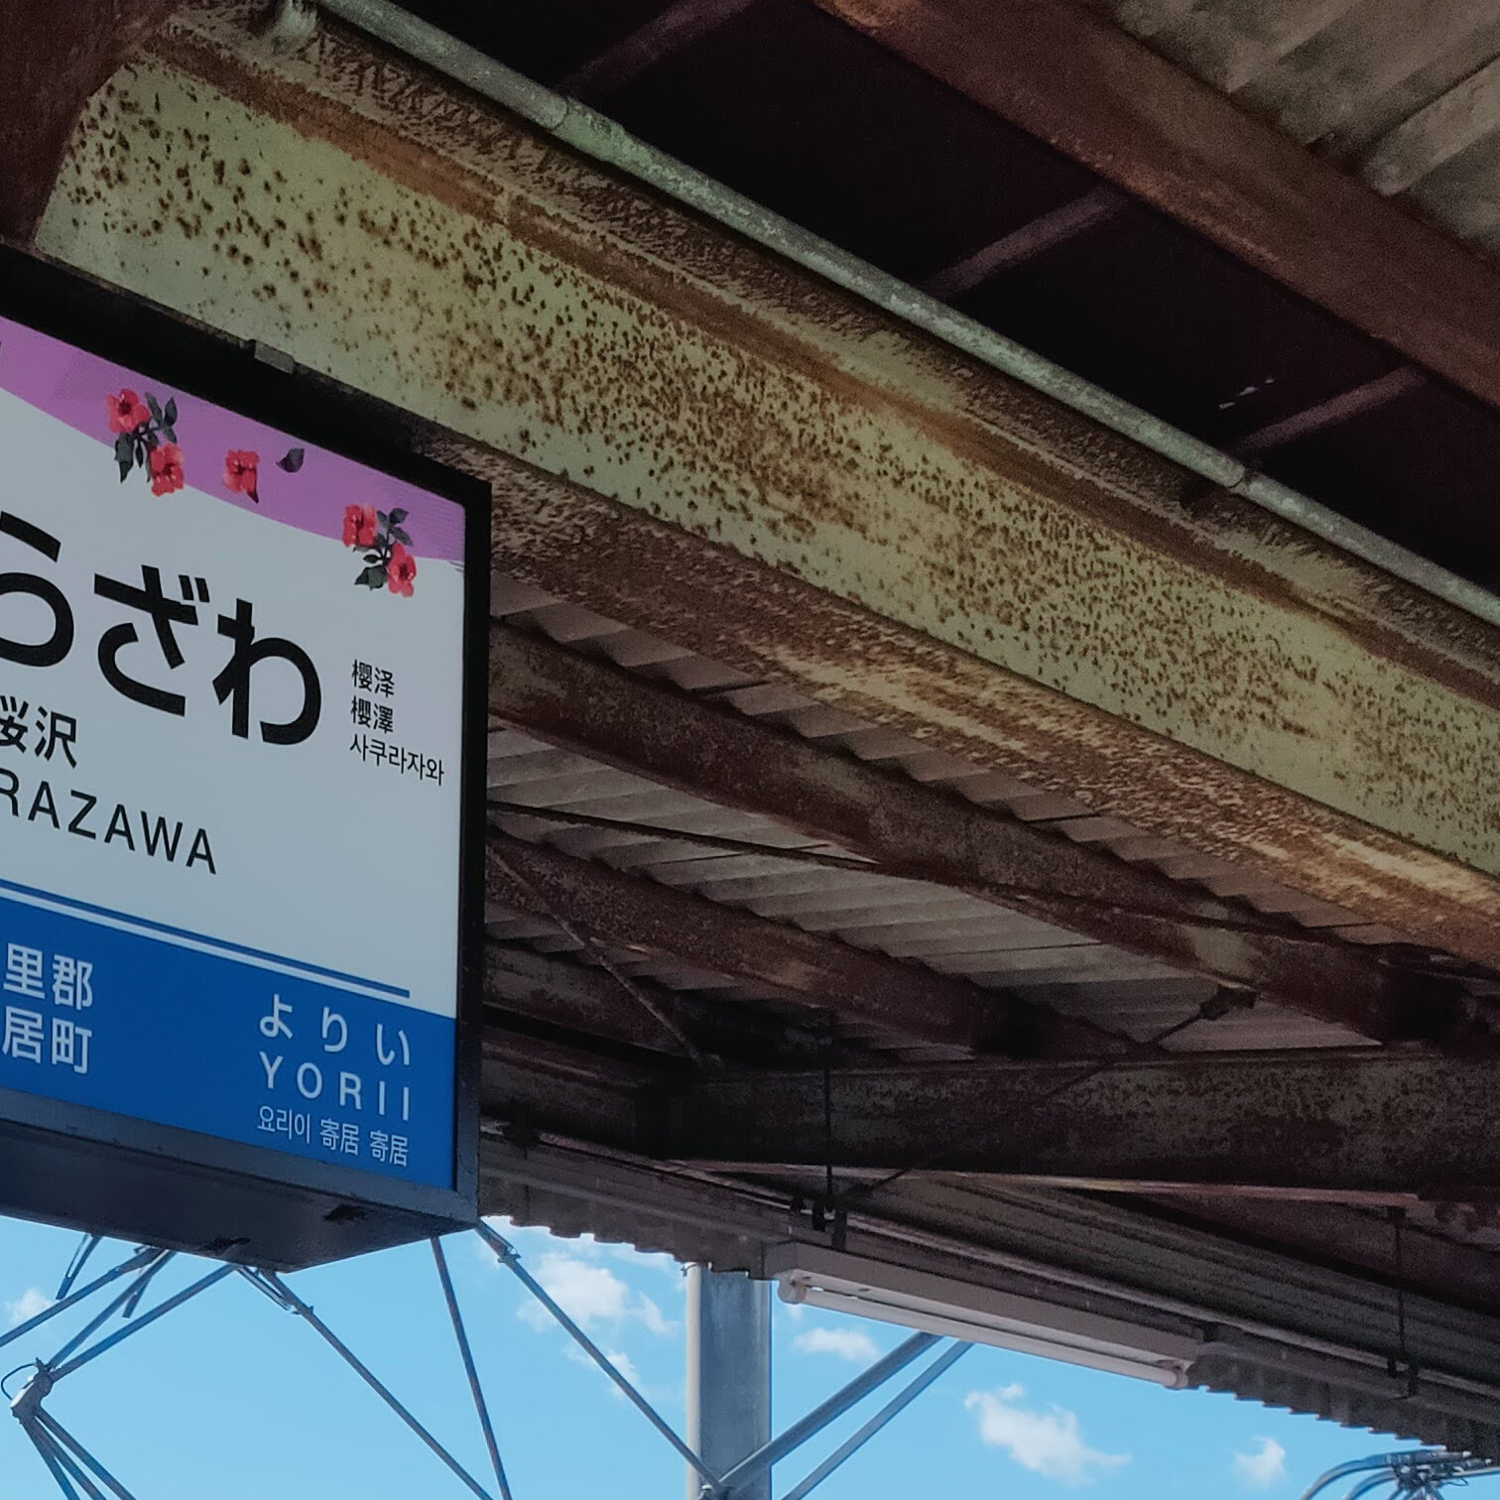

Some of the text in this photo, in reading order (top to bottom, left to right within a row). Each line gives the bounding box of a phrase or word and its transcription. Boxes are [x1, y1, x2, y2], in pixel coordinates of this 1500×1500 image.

[349, 733, 445, 787] 사쿠라자와
[259, 993, 410, 1066] よりい
[259, 1050, 410, 1121] YORII
[257, 1105, 409, 1167] 요리이 寄居 寄居
